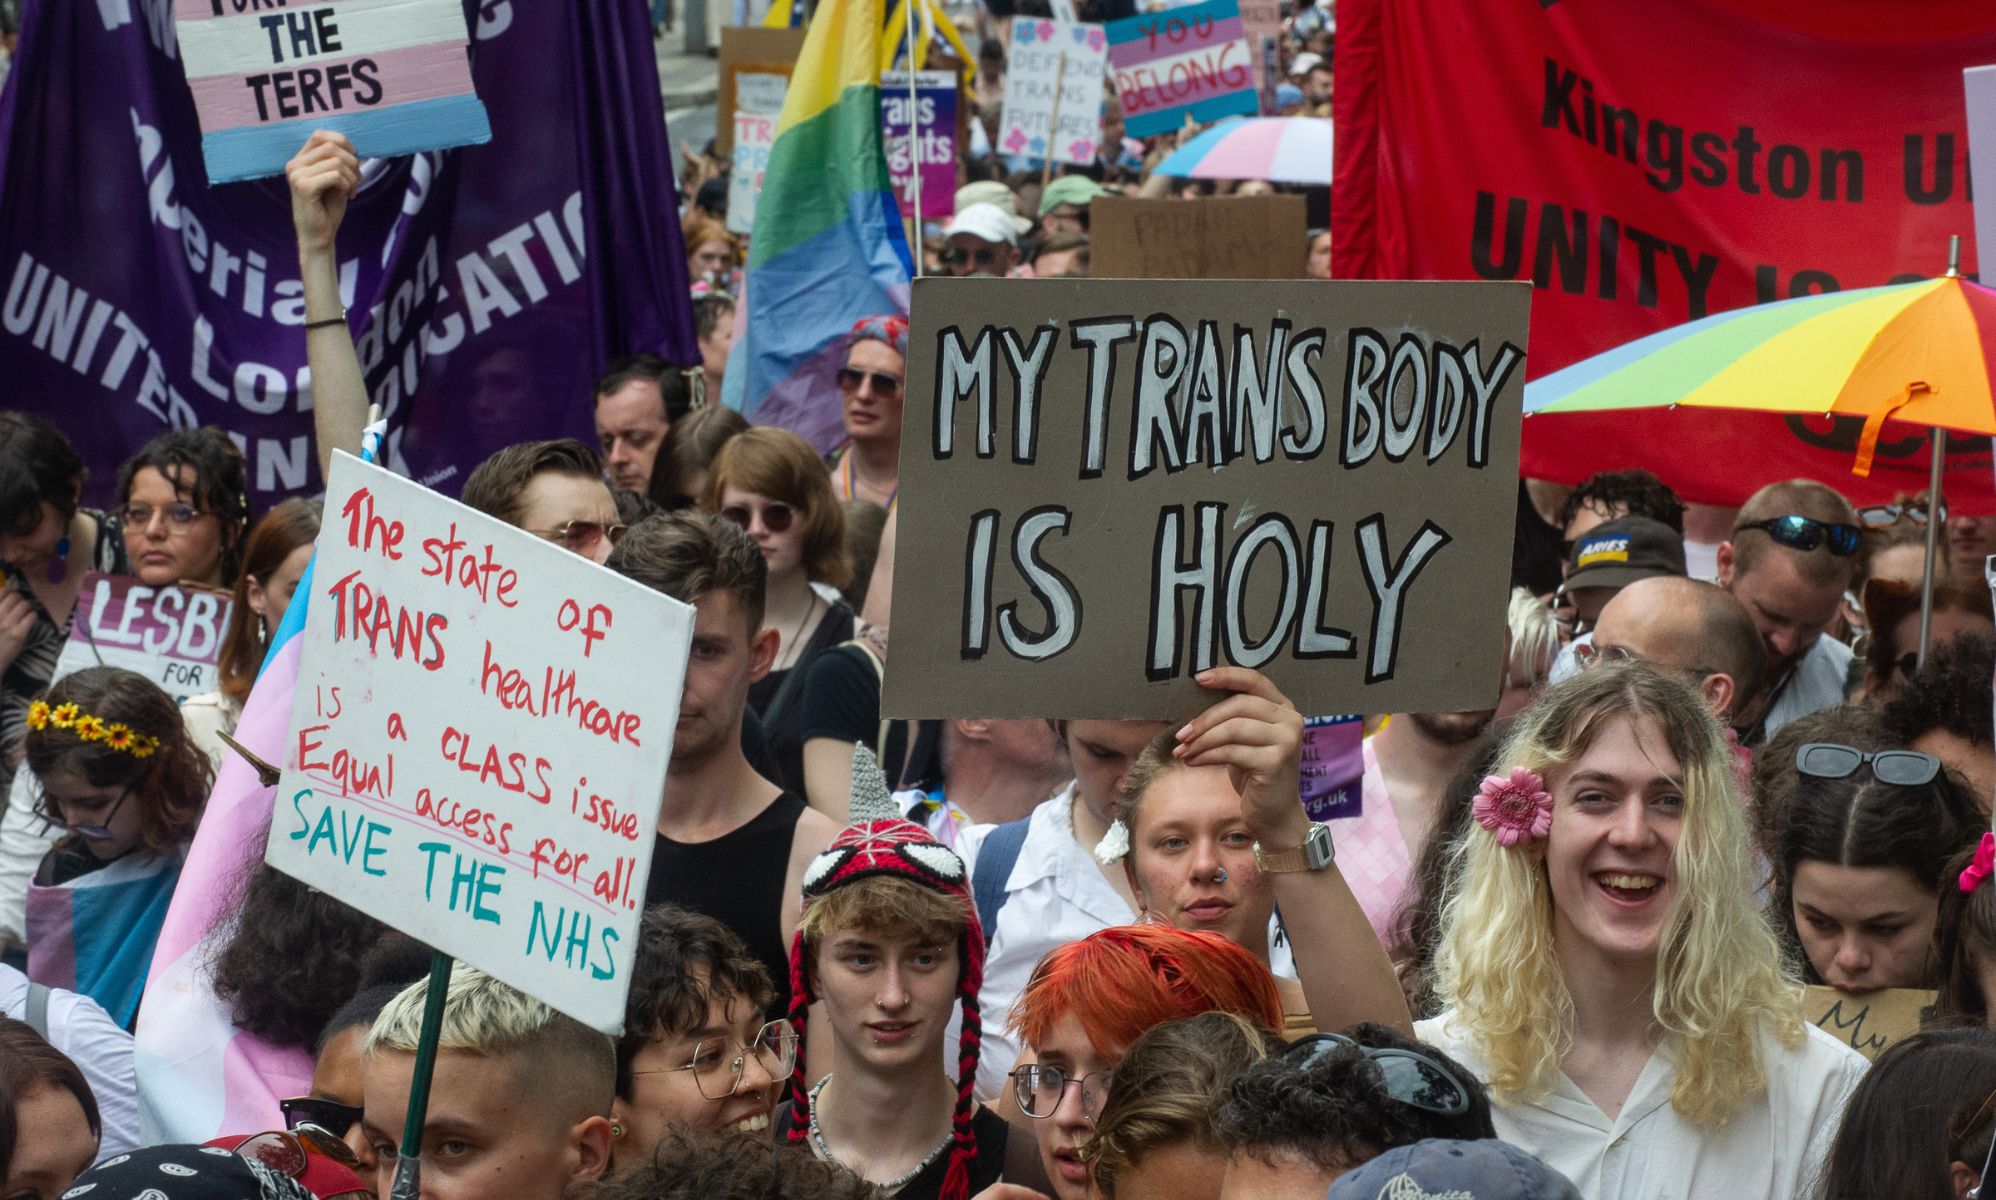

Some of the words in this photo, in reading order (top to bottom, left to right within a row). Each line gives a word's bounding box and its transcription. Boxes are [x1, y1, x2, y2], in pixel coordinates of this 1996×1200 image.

[259, 8, 342, 64] THE
[1013, 51, 1100, 78] DEFEND
[1115, 41, 1247, 113] BELONG
[1138, 15, 1213, 52] YOU
[246, 59, 382, 122] TERFS
[1007, 108, 1094, 138] FUTURES
[1013, 80, 1087, 105] TRANS
[1541, 57, 1866, 204] Kingston
[1902, 133, 1974, 206] U
[1470, 191, 1719, 317] UNITY
[932, 323, 1061, 467] MY
[1068, 312, 1328, 482] TRANS
[1339, 325, 1527, 470] BODY
[89, 578, 233, 662] LESBI
[342, 487, 404, 560] The
[421, 523, 518, 608] state
[557, 599, 612, 657] of
[960, 505, 1083, 663] IS
[1145, 500, 1453, 686] HOLY
[163, 662, 203, 686] FOR
[329, 569, 448, 670] TRANS
[481, 642, 642, 747] healthcare
[316, 672, 342, 719] is
[387, 711, 407, 743] a
[441, 727, 553, 804] CLASS
[572, 777, 639, 841] issue
[298, 724, 394, 798] Equal
[415, 787, 513, 855] access
[530, 837, 589, 882] for
[593, 856, 636, 911] all.
[289, 788, 393, 878] SAVE
[417, 842, 506, 926] THE
[526, 901, 620, 981] NHS
